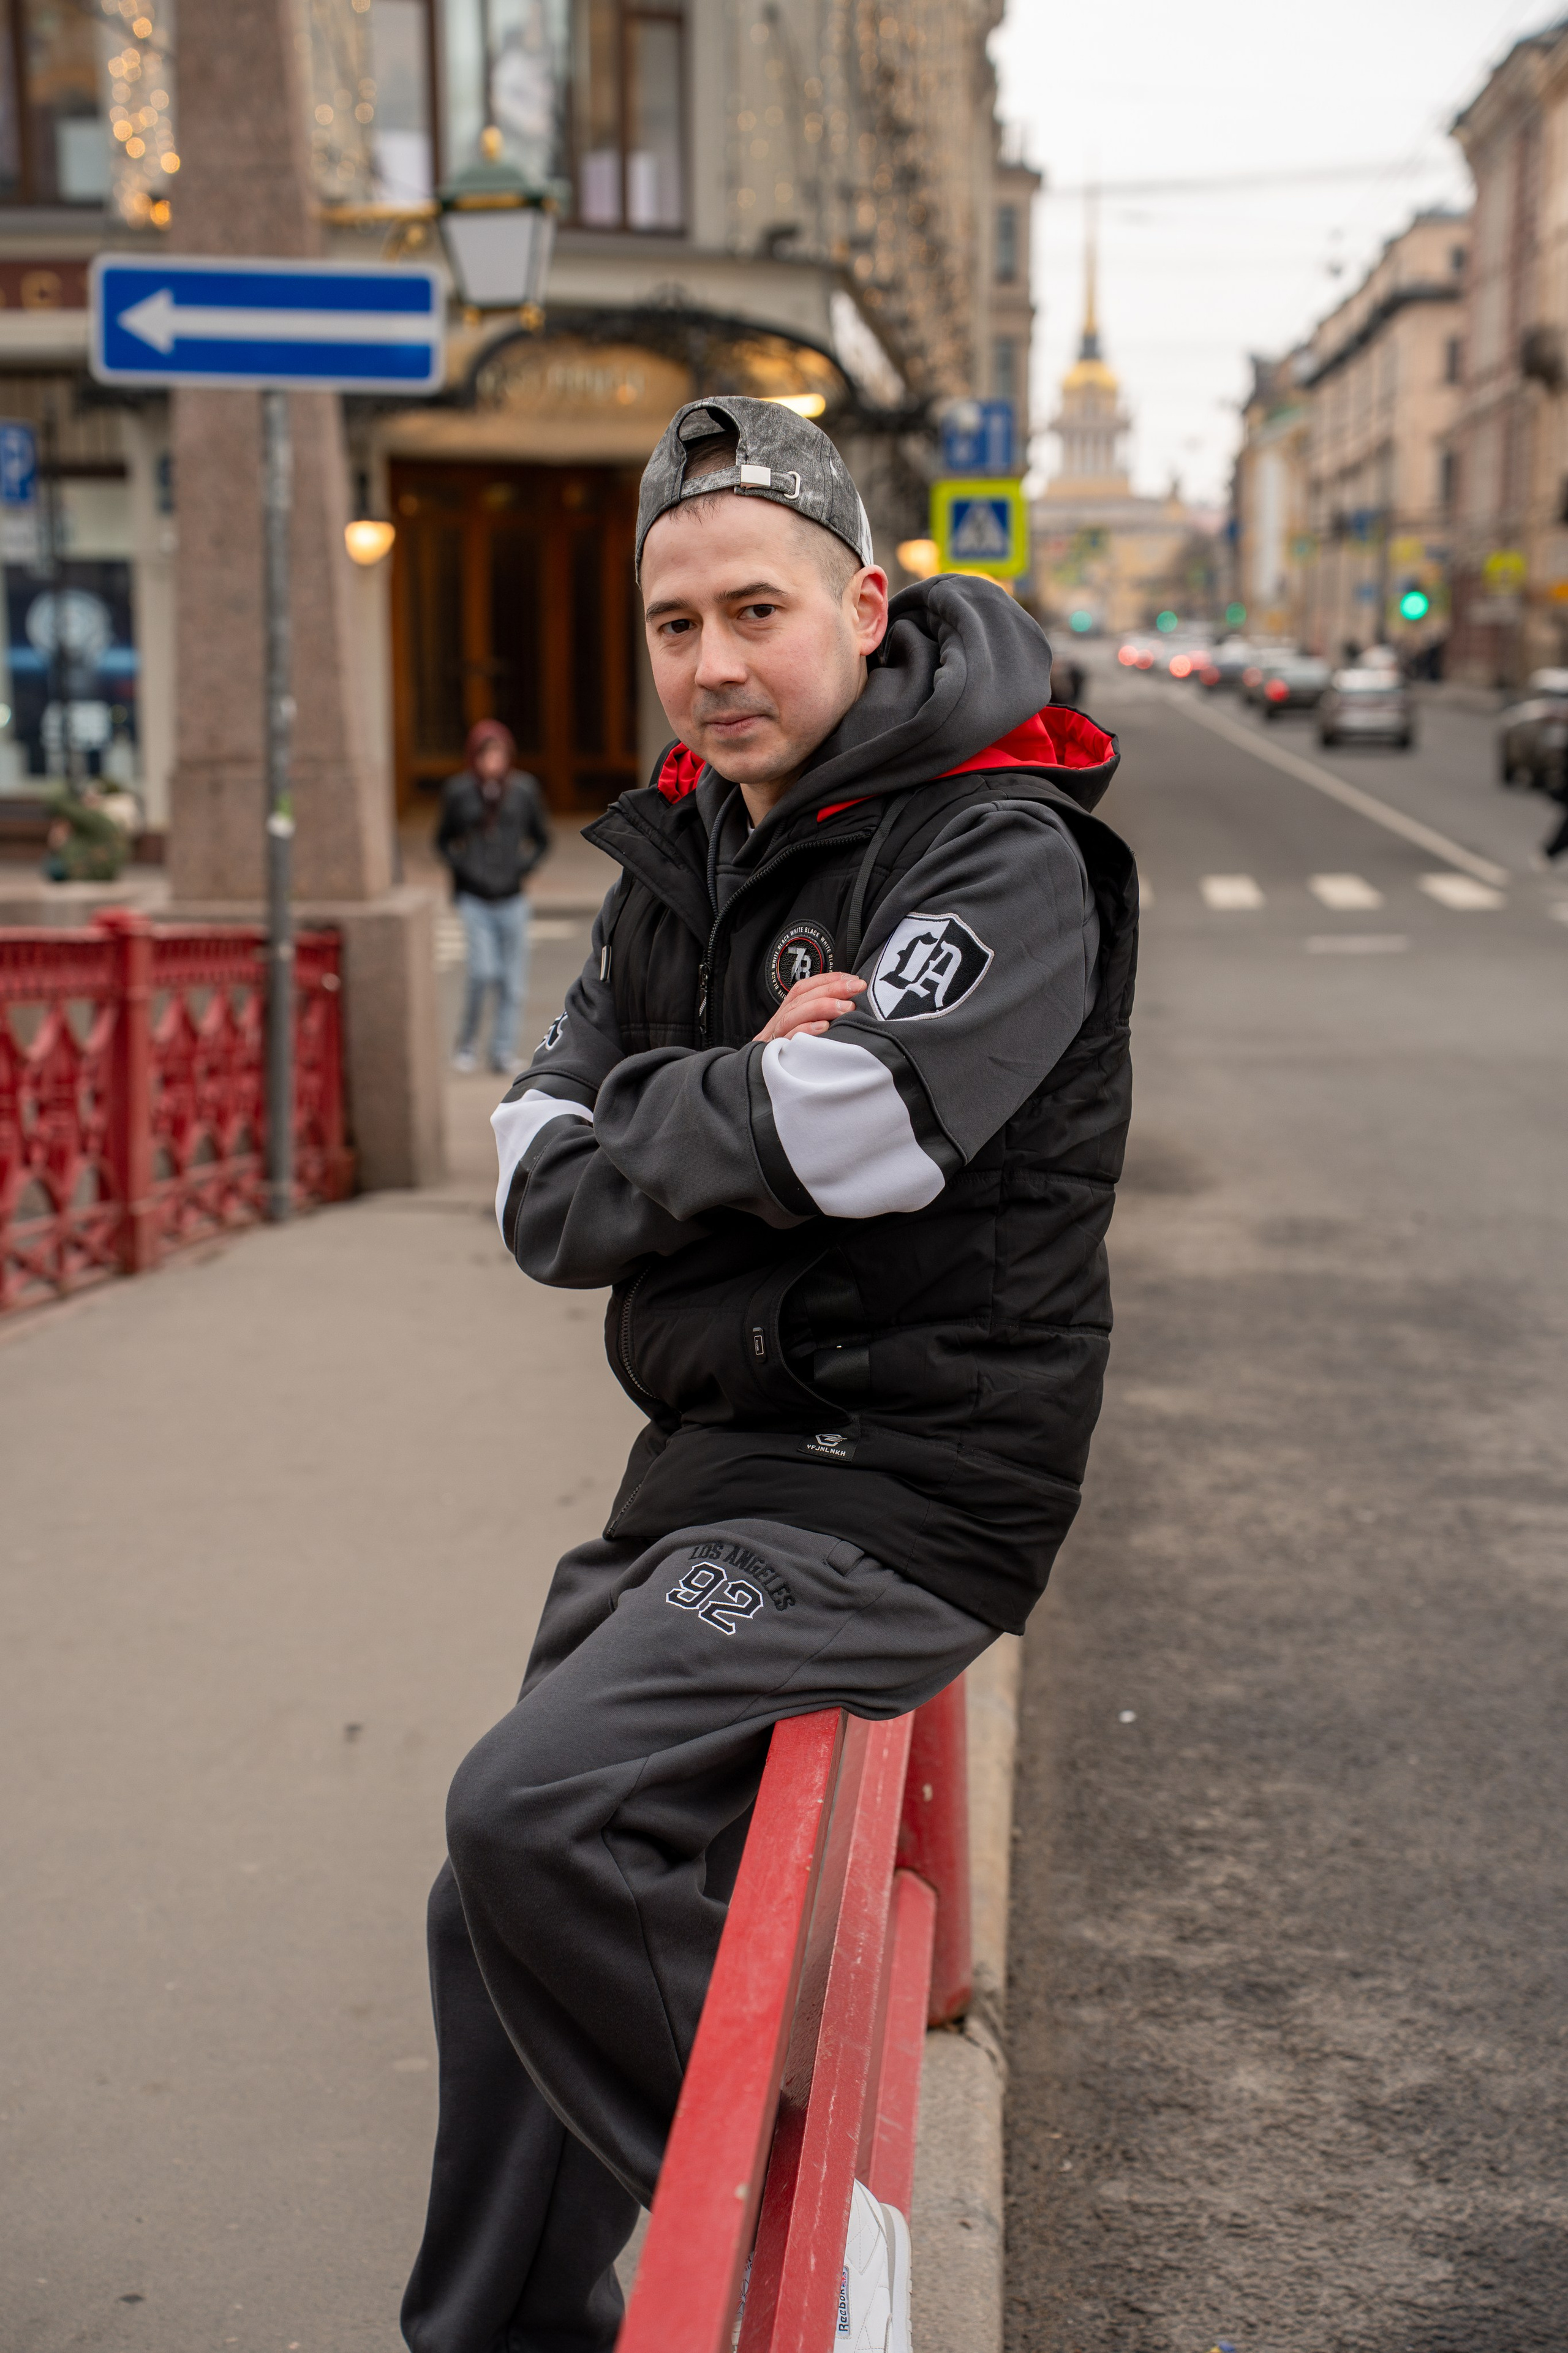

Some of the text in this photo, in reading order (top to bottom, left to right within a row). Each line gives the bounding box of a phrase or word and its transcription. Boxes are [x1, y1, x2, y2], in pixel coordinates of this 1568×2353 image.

[771, 971, 780, 990] BLACK
[777, 934, 790, 950] BLACK
[790, 926, 804, 936] WHITE
[804, 926, 820, 938] BLACK
[820, 935, 832, 953] WHITE
[787, 946, 812, 983] 78
[879, 931, 962, 1008] LA
[807, 1444, 846, 1457] YFJNLNKH
[665, 1561, 764, 1636] 92
[688, 1541, 796, 1612] LOS ANGELES
